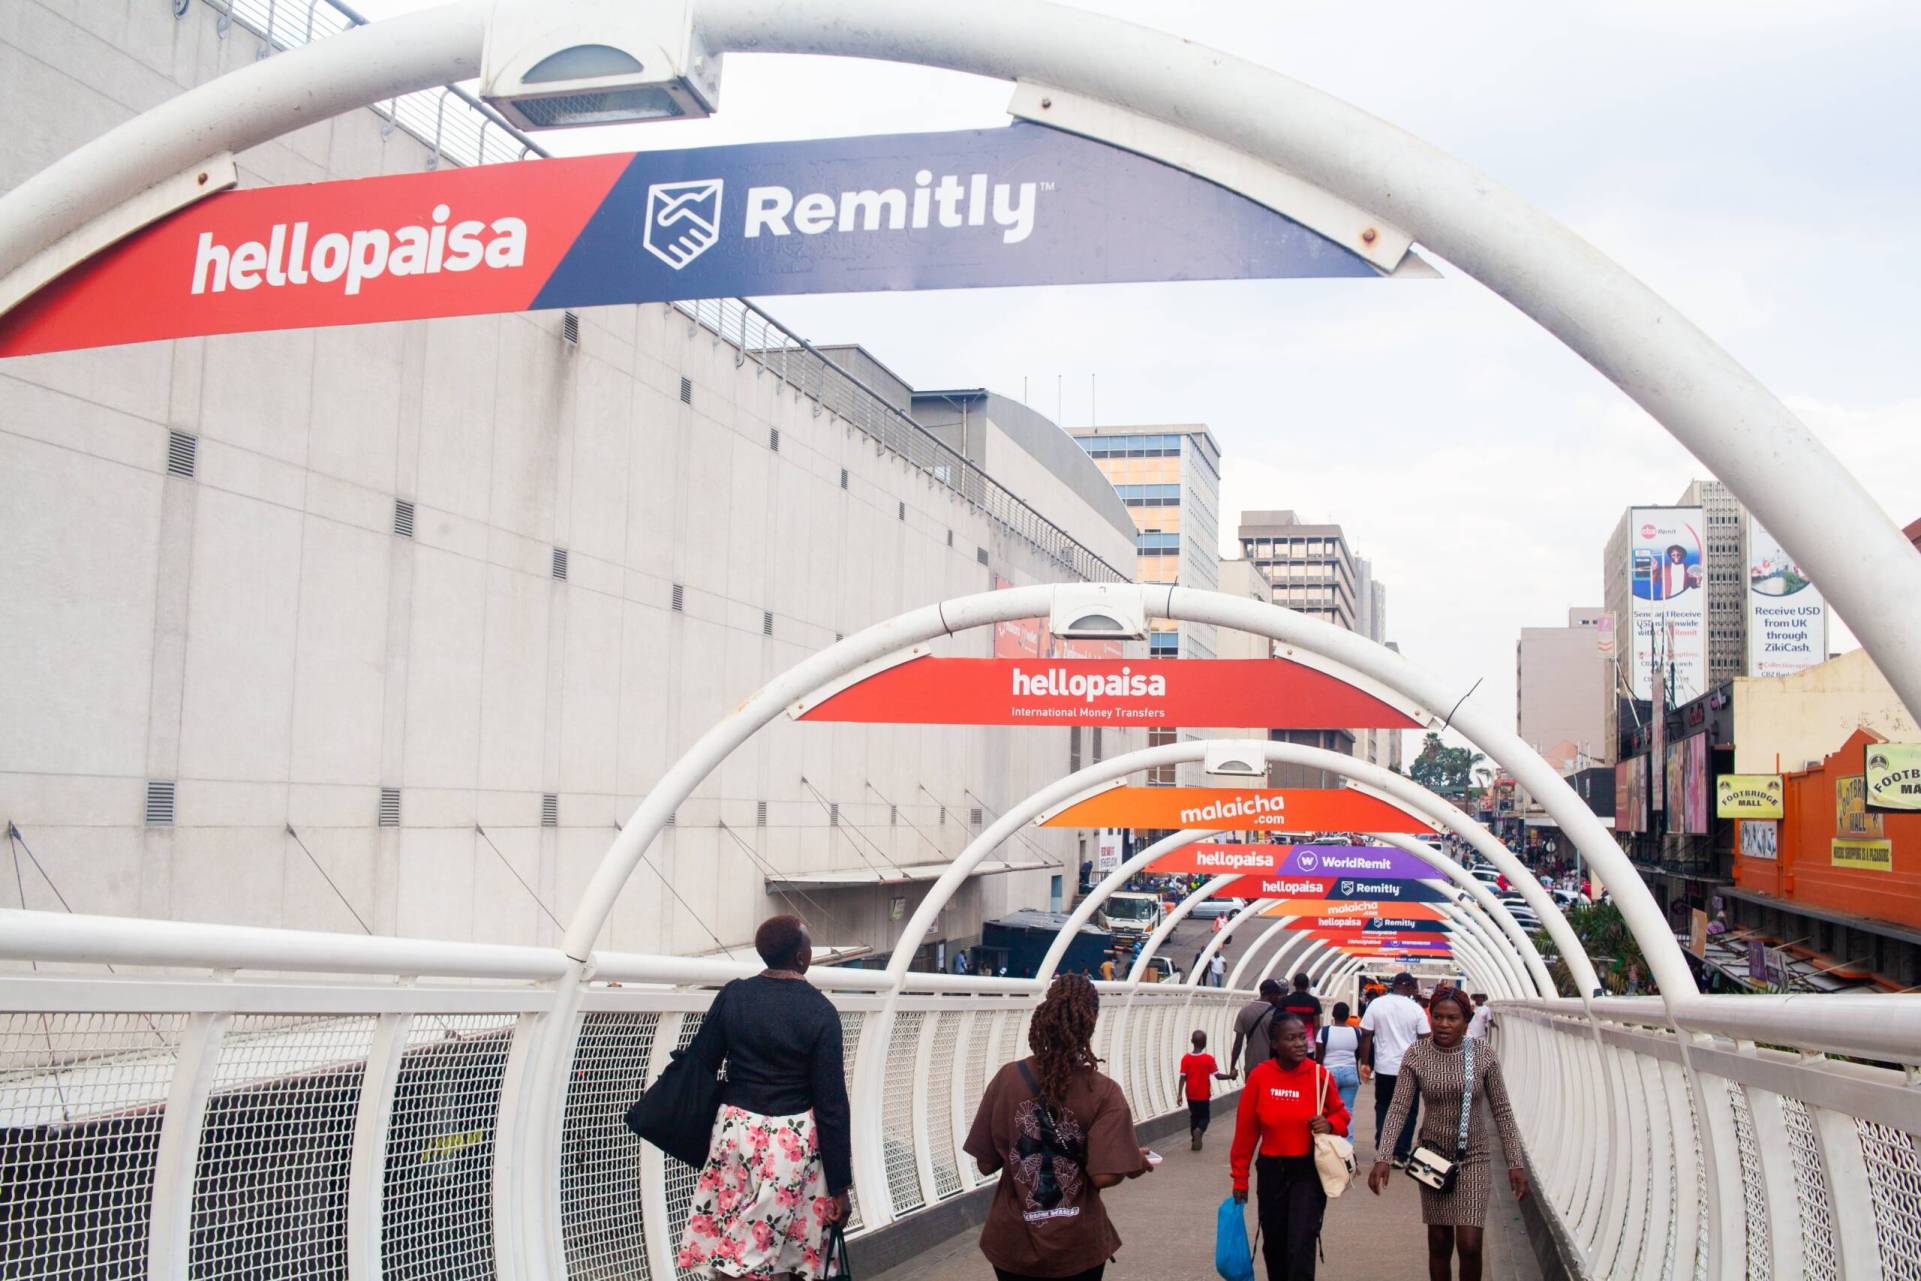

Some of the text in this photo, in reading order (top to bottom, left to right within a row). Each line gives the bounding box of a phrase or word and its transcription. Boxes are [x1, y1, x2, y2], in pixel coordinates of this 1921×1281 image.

[744, 169, 1037, 244] Remitly
[191, 203, 527, 295] hellopaisa
[1755, 606, 1820, 615] Receive USD
[1765, 619, 1807, 627] from UK
[1767, 631, 1808, 642] through
[1012, 667, 1166, 702] hellopaisa
[1012, 707, 1165, 719] International Money Transfers
[1721, 790, 1778, 806] FOOTBRIDGE
[1181, 794, 1284, 823] malaicha
[1254, 815, 1284, 824] .com
[1197, 851, 1274, 869] hellopaisa
[1322, 856, 1391, 869] WorldRemit
[1262, 881, 1324, 894] hellopaisa
[1356, 883, 1400, 896] Remitly
[1318, 918, 1361, 927] hellopaisa
[1384, 919, 1415, 928] Remitly
